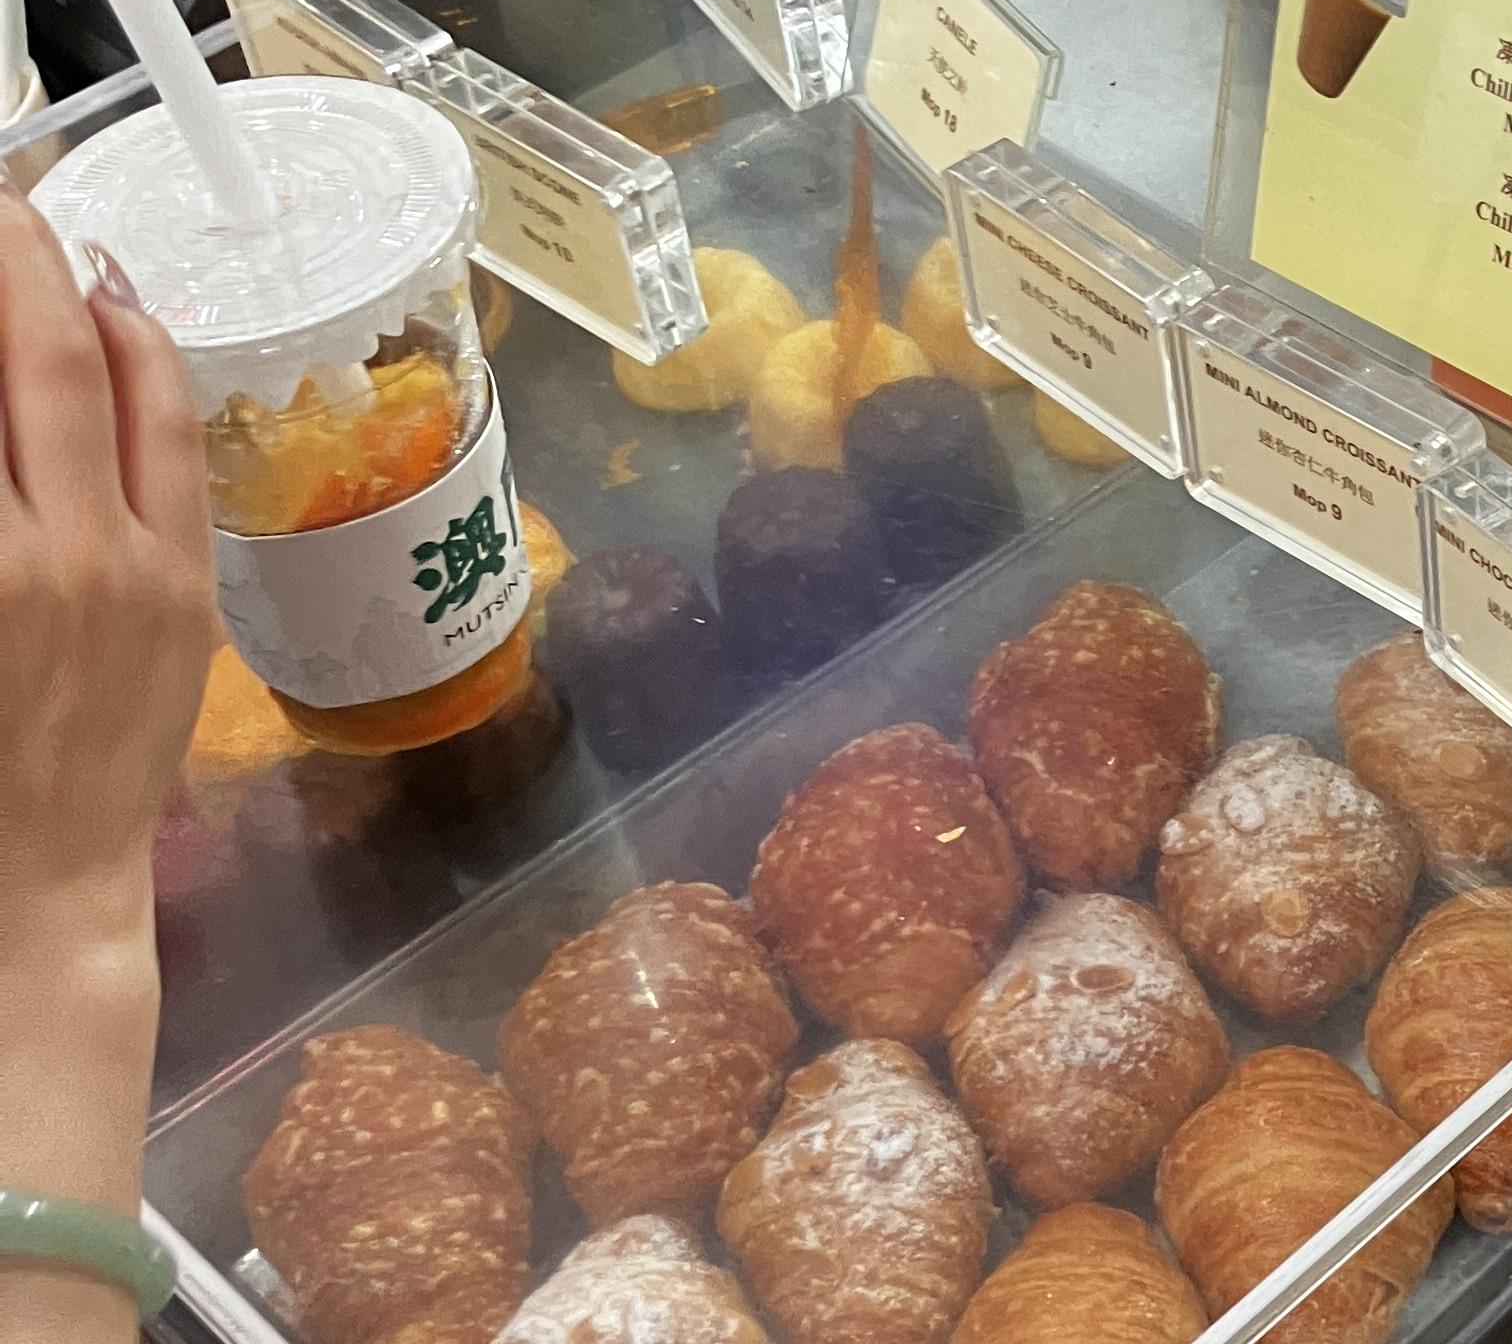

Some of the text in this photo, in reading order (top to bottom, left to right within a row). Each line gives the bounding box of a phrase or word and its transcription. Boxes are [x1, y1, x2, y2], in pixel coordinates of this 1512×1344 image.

[937, 6, 978, 56] CANELE
[921, 87, 941, 117] Mop
[1007, 235, 1064, 283] CHEESE
[1066, 276, 1149, 341] CROISSANT
[1050, 331, 1080, 361] Mop
[1205, 362, 1423, 489] MINI ALMOND CROISSANT
[1292, 483, 1343, 521] Mop 9
[1436, 520, 1465, 554] MINI
